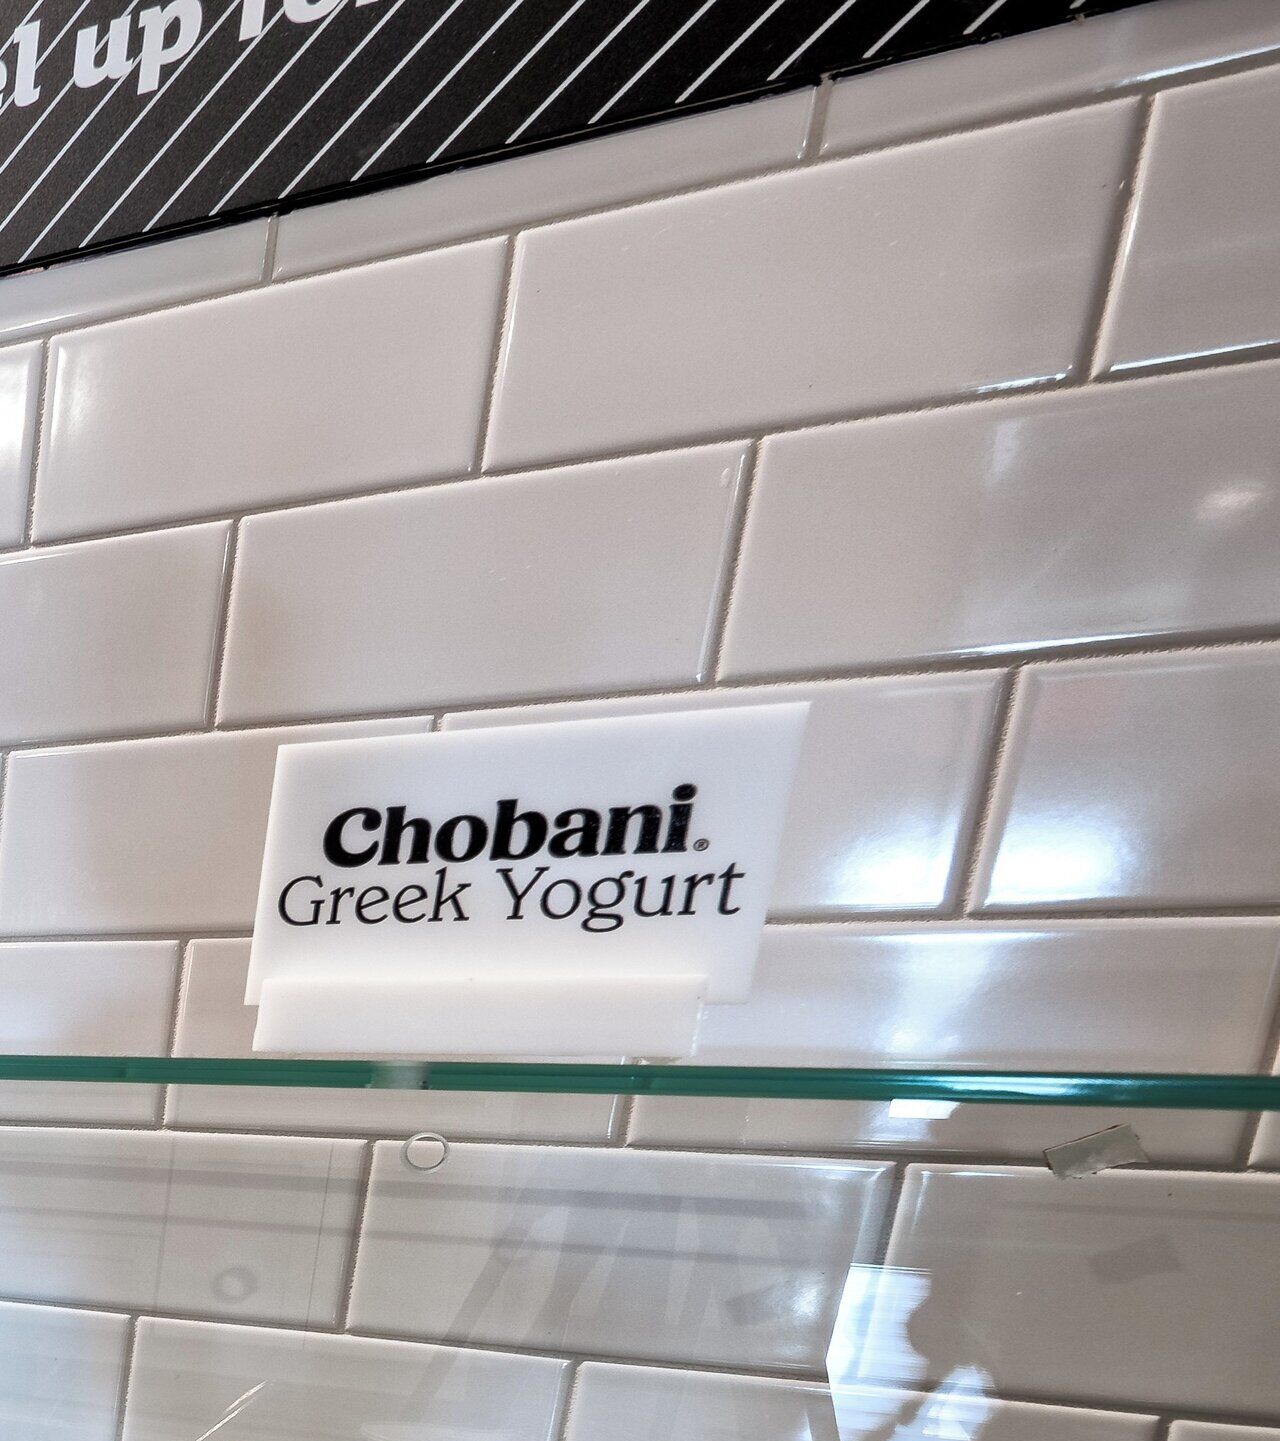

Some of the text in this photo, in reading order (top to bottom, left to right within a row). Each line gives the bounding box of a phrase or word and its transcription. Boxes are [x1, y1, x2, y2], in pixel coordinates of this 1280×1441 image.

[73, 0, 203, 95] up
[277, 861, 746, 934] Greek Yogurt
